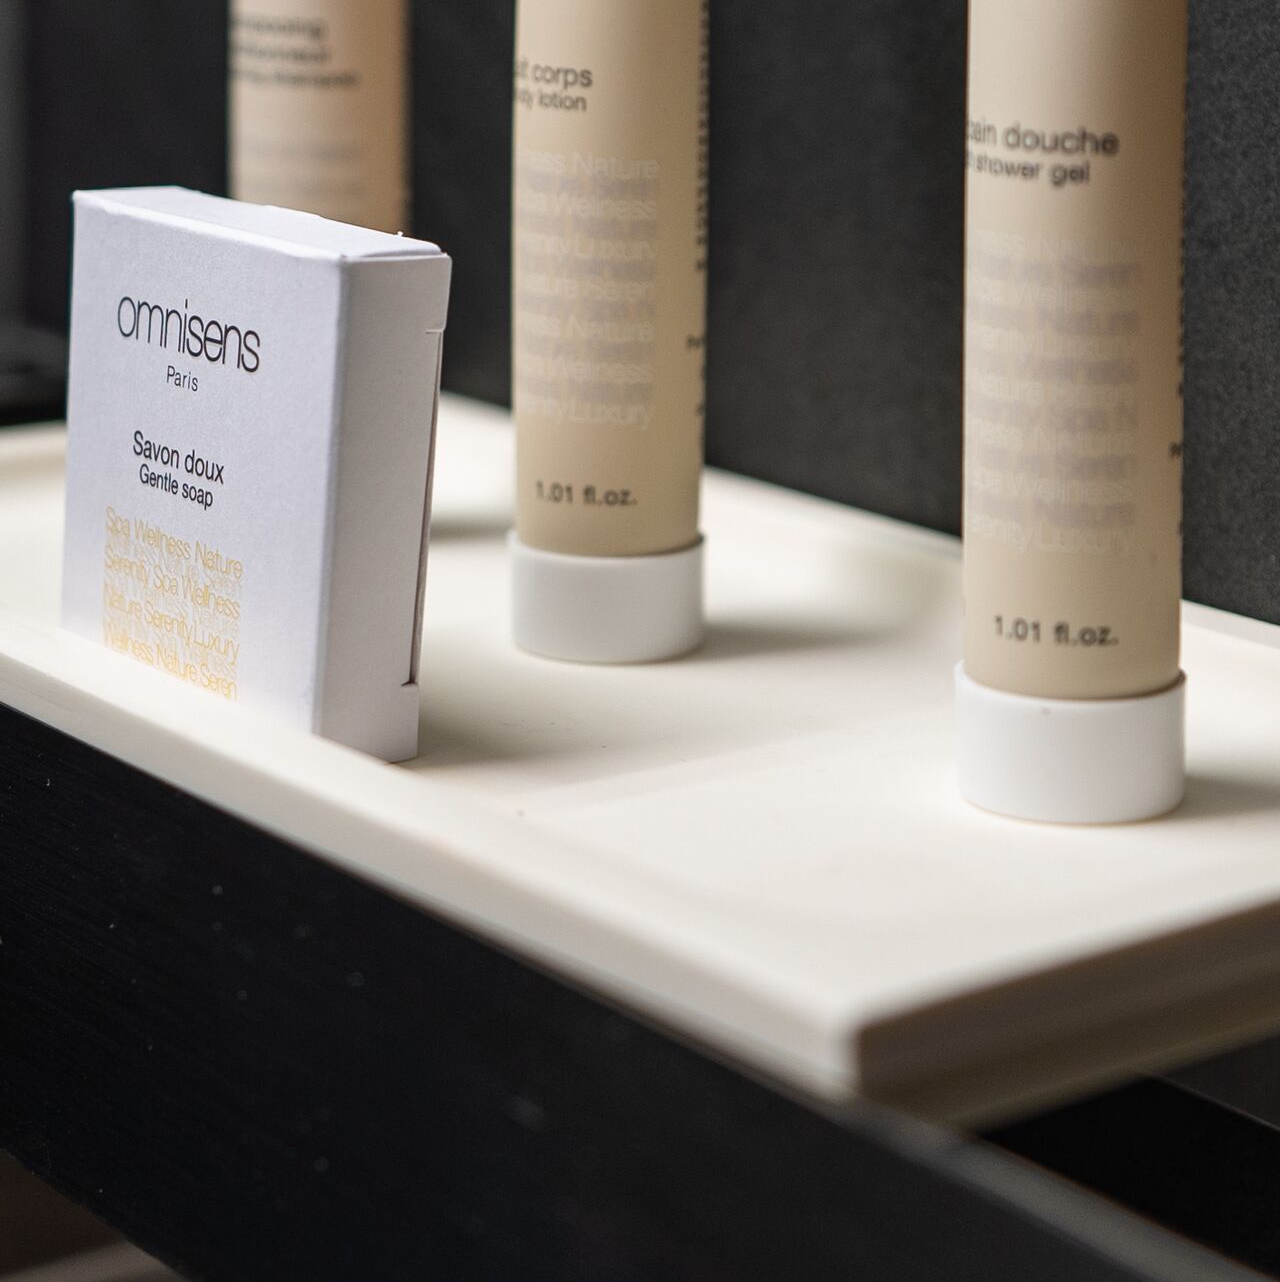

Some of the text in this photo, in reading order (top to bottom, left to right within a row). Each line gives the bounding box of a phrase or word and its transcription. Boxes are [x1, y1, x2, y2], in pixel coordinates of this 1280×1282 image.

[532, 63, 593, 90] corps
[539, 89, 587, 110] lotion
[1004, 122, 1119, 156] douche
[976, 152, 1040, 181] shower
[1051, 161, 1090, 188] gel
[117, 296, 261, 373] omnisens
[166, 365, 199, 392] Paris
[133, 430, 225, 485] Savon doux
[139, 463, 214, 511] Gentle soap
[536, 480, 574, 504] 1.01
[134, 517, 192, 560] Wellness
[195, 540, 243, 579] Nature
[182, 573, 240, 619] Wellness
[993, 615, 1040, 644] 1.01
